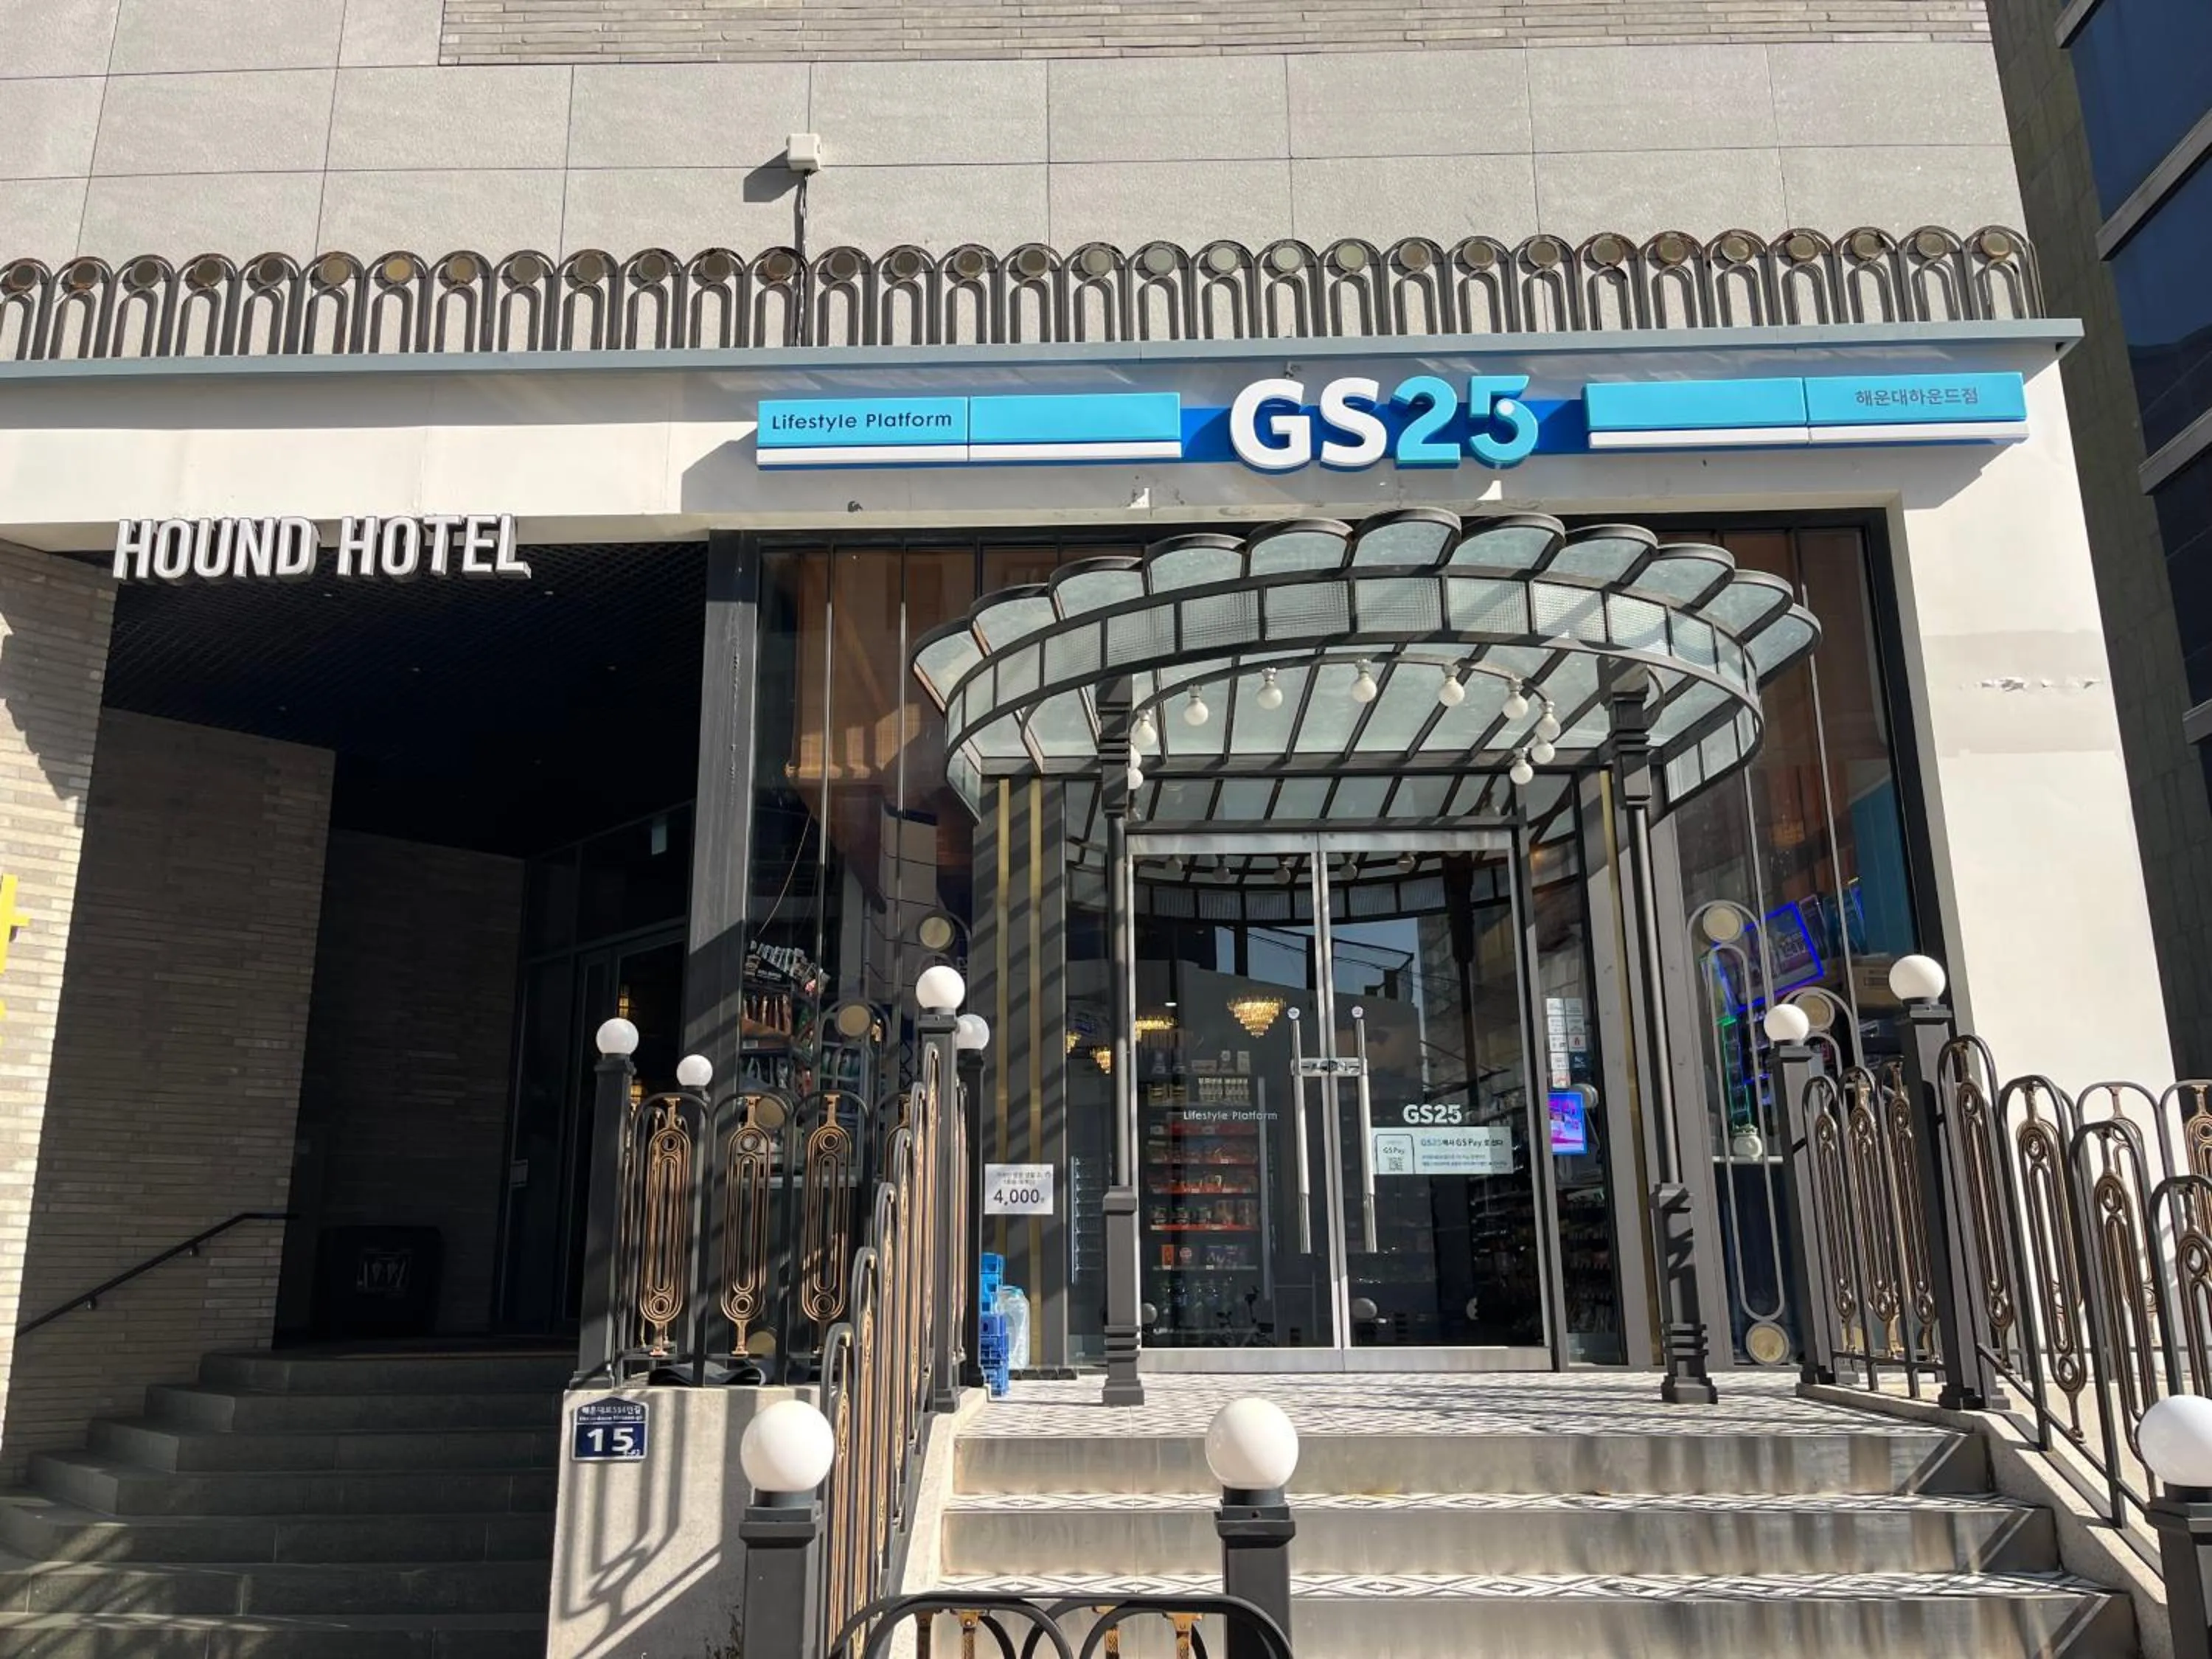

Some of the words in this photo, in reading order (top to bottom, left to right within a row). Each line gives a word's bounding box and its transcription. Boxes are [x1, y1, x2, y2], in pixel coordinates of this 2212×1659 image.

[1854, 387, 1979, 407] 해운대하운드점
[771, 414, 858, 431] Lifestyle
[866, 411, 953, 428] Platform
[1229, 375, 1539, 472] GS25
[112, 517, 319, 581] HOUND
[336, 514, 532, 580] HOTEL
[1183, 1110, 1228, 1121] Lifestyle
[1231, 1110, 1279, 1121] Platform
[1402, 1104, 1463, 1124] GS25
[993, 1189, 1040, 1206] 4,000
[587, 1427, 634, 1452] 15
